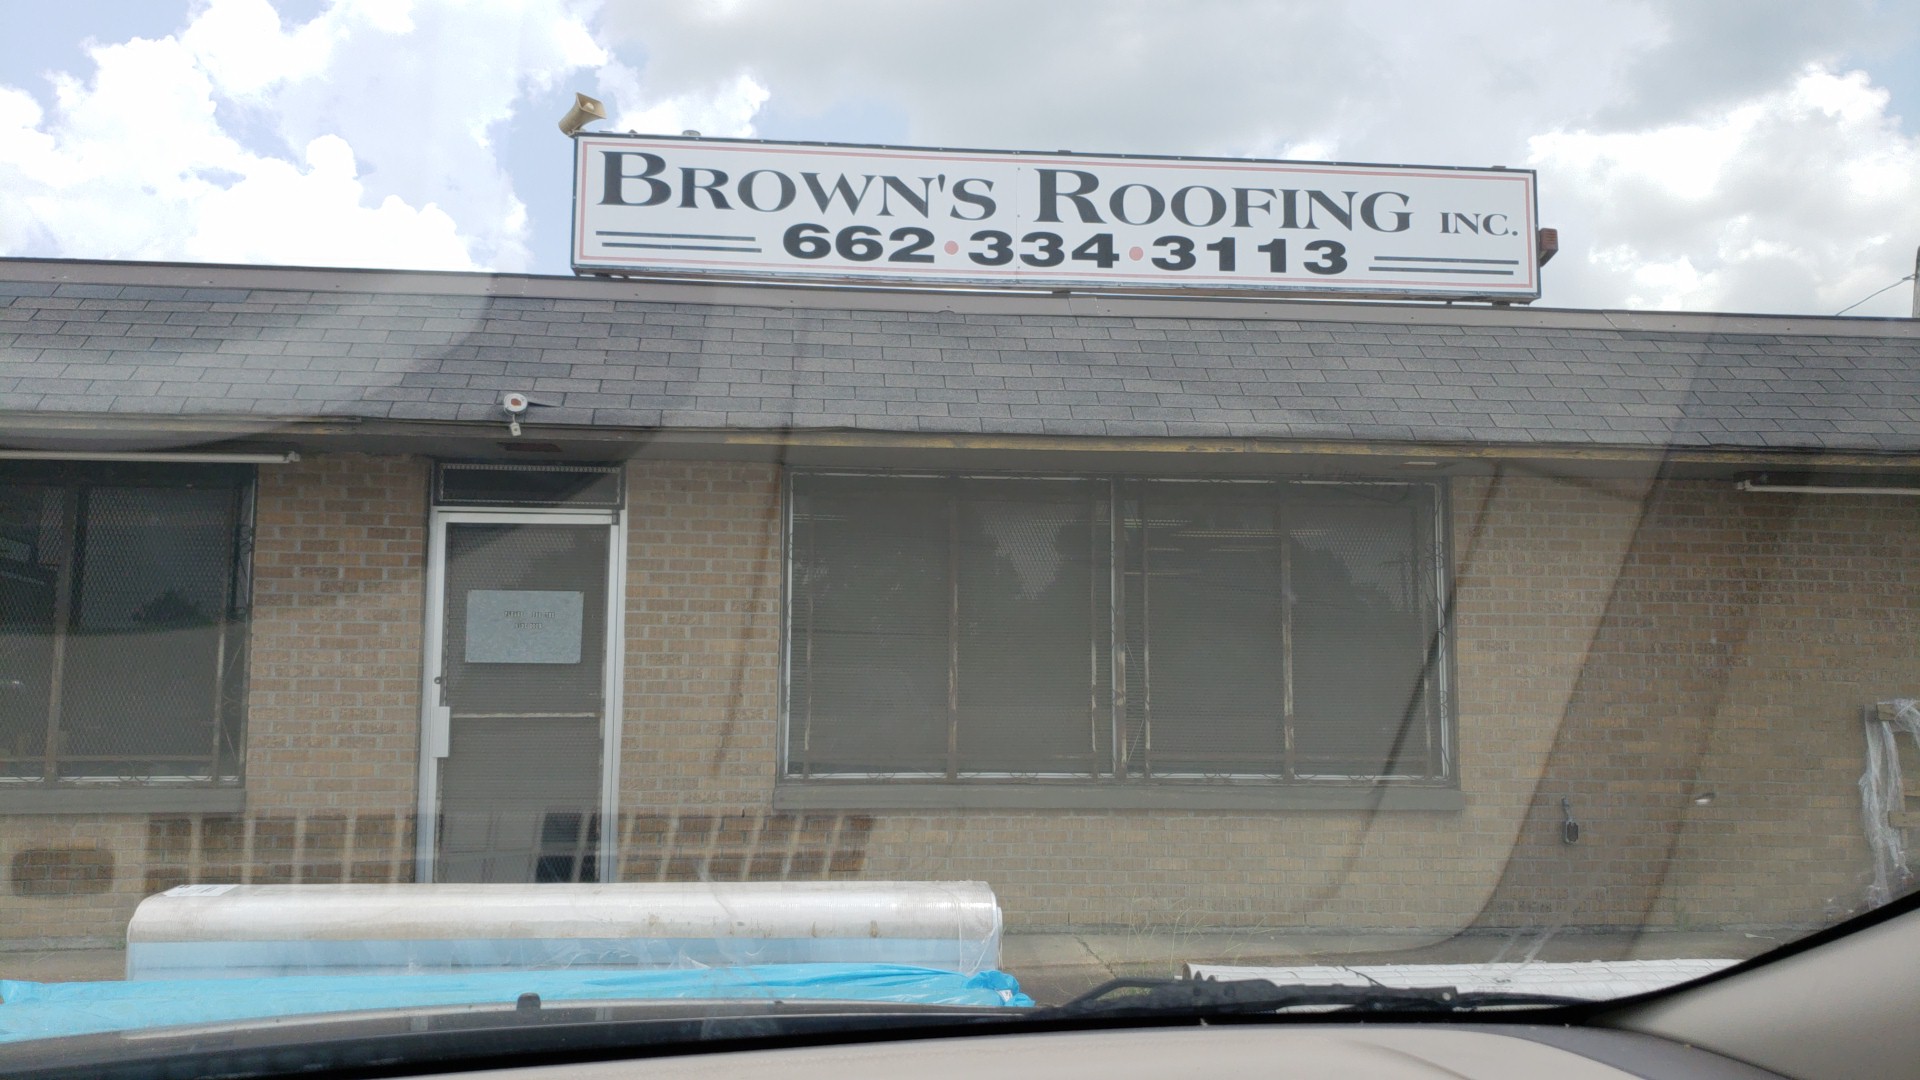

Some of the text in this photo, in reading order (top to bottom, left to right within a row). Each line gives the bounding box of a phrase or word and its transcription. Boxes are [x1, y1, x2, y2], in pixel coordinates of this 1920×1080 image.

[596, 150, 1519, 237] BROWN'S ROOFING INC.
